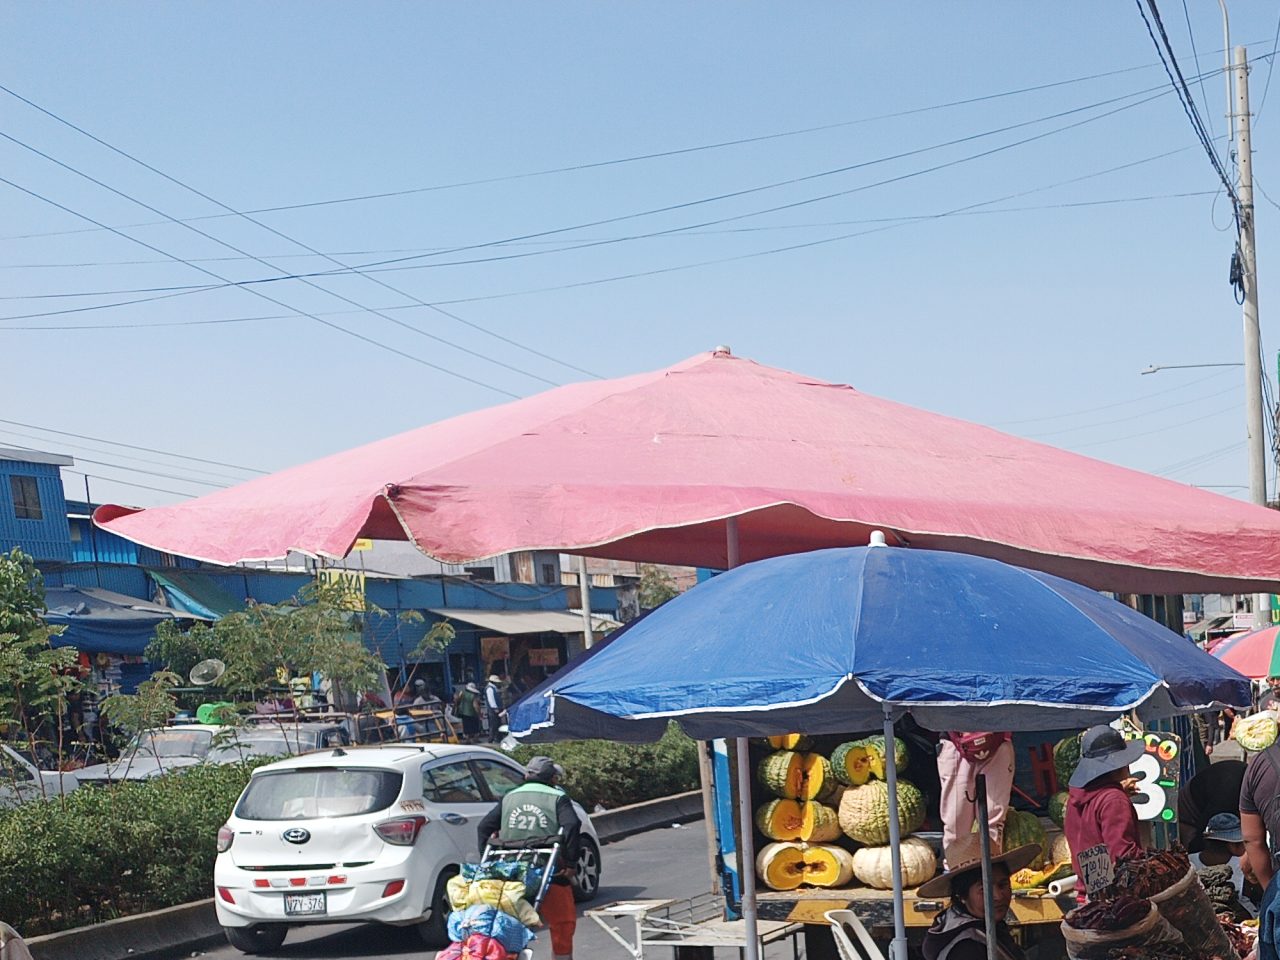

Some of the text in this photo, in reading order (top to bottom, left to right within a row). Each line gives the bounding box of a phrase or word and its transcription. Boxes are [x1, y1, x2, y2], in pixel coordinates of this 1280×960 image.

[318, 571, 363, 592] PLAYA
[1128, 753, 1166, 820] 3
[517, 815, 537, 830] 27
